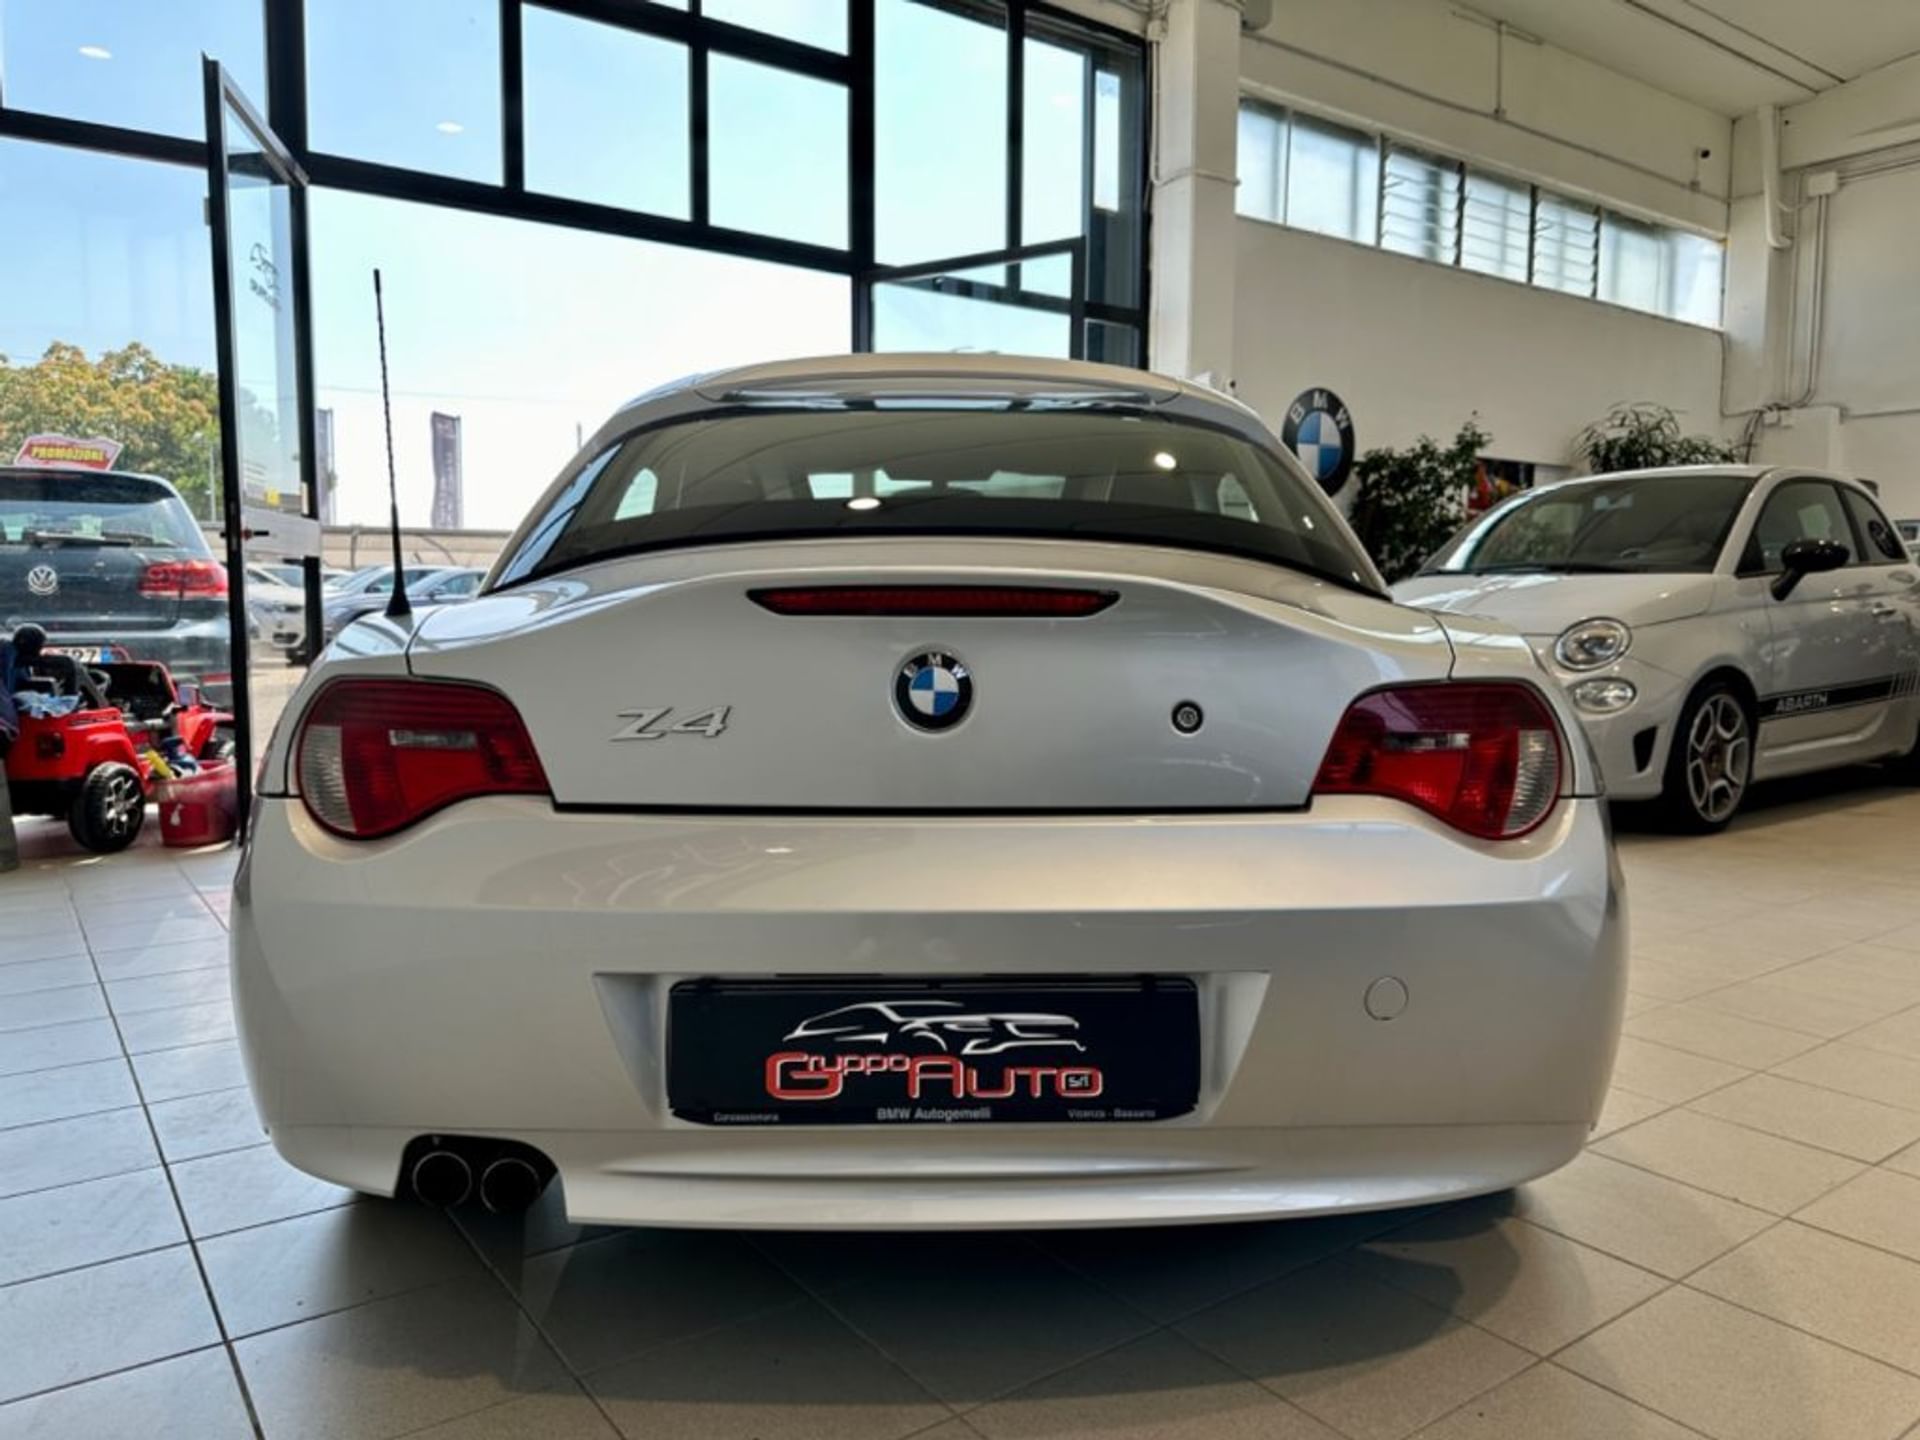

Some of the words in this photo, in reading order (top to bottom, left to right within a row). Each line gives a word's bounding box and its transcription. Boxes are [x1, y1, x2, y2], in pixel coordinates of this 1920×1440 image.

[1290, 390, 1351, 430] BMW
[903, 652, 968, 680] BMW
[1776, 691, 1828, 711] ABARTH
[609, 706, 732, 742] Z4
[876, 1107, 911, 1120] BMW
[914, 1107, 991, 1122] Autogemelli
